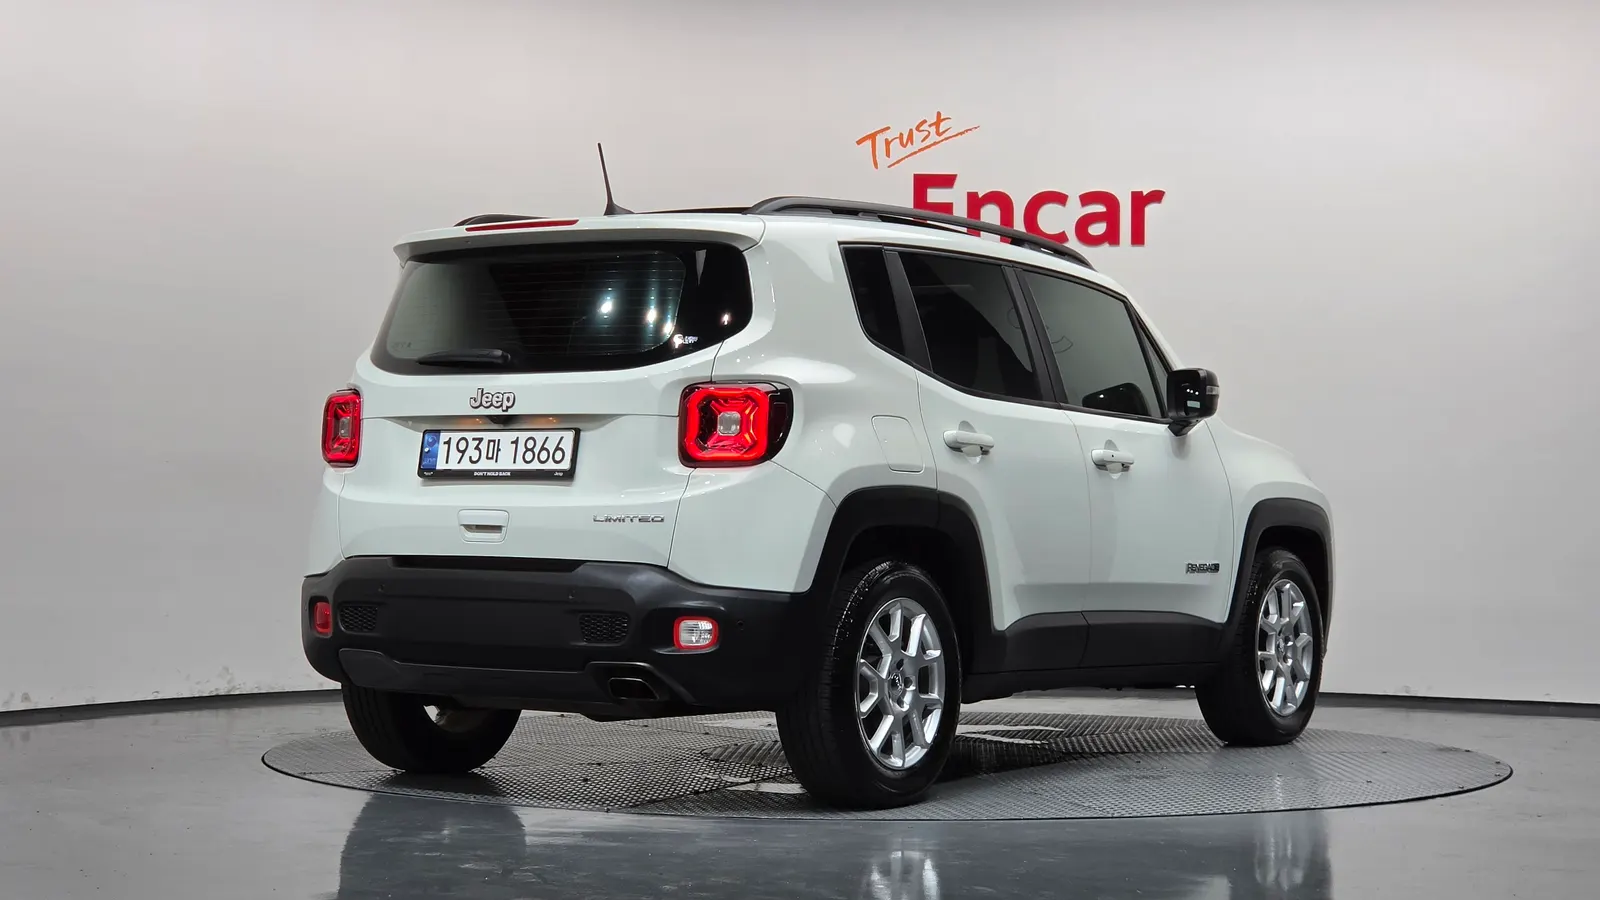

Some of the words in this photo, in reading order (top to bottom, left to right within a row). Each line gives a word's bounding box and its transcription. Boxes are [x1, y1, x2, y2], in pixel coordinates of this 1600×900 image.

[856, 111, 952, 169] Trust
[912, 173, 1166, 247] Encar
[469, 388, 516, 412] Jeep
[443, 436, 501, 464] 193마
[510, 436, 566, 464] 1866
[592, 514, 665, 523] LIMITED
